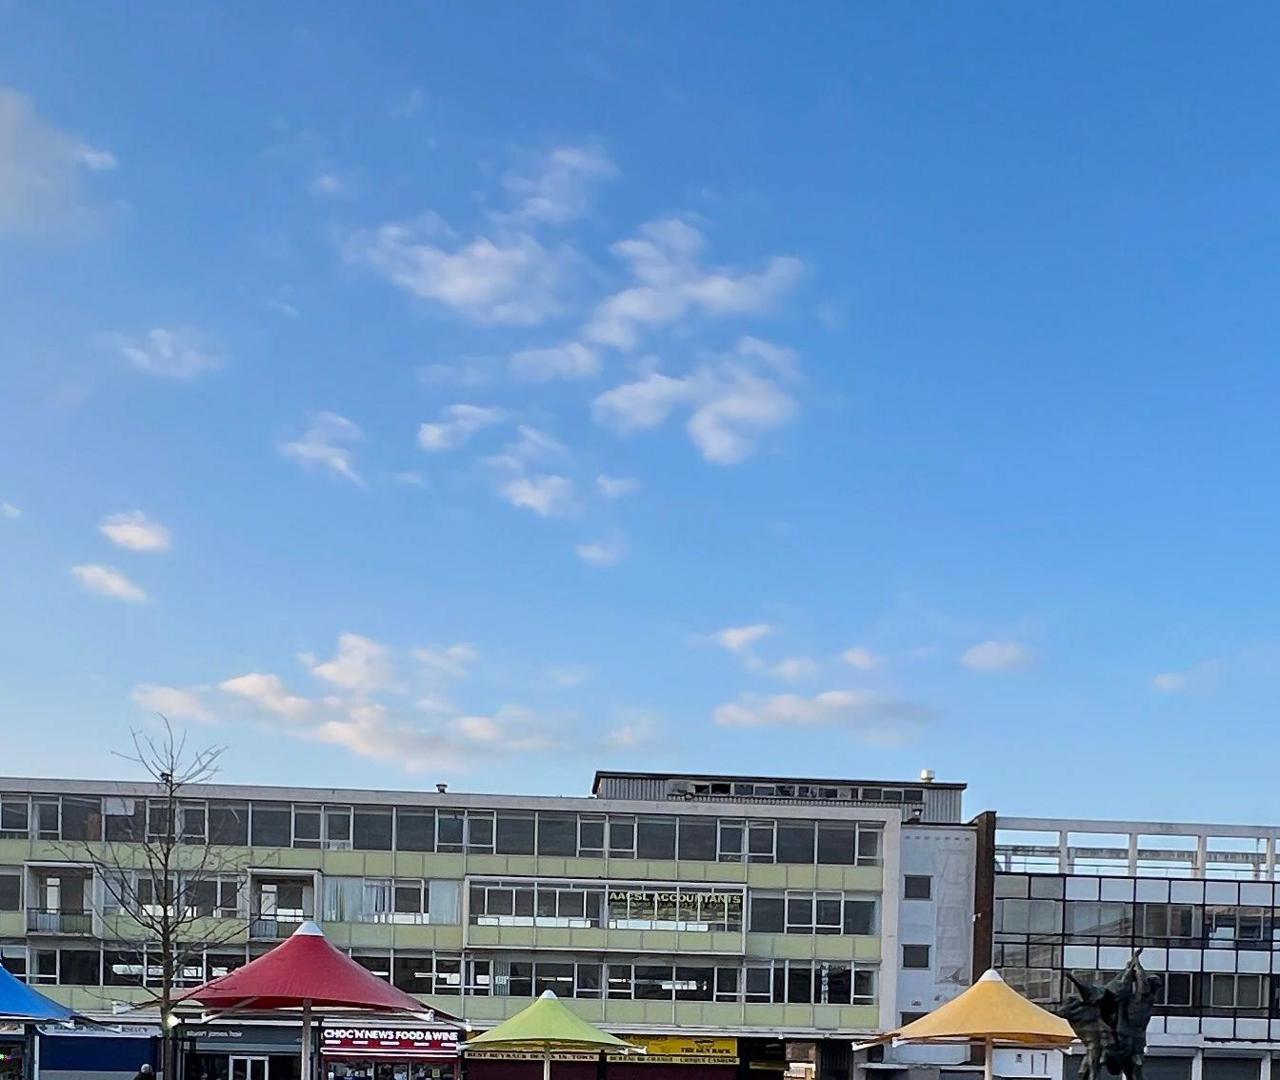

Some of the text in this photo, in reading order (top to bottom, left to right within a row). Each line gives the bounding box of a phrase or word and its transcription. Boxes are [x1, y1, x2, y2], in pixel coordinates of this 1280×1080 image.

[609, 892, 742, 904] AACSL ACCOUNTANTS
[396, 1030, 425, 1041] FOOD
[425, 1031, 433, 1040] &
[433, 1031, 459, 1041] WINE
